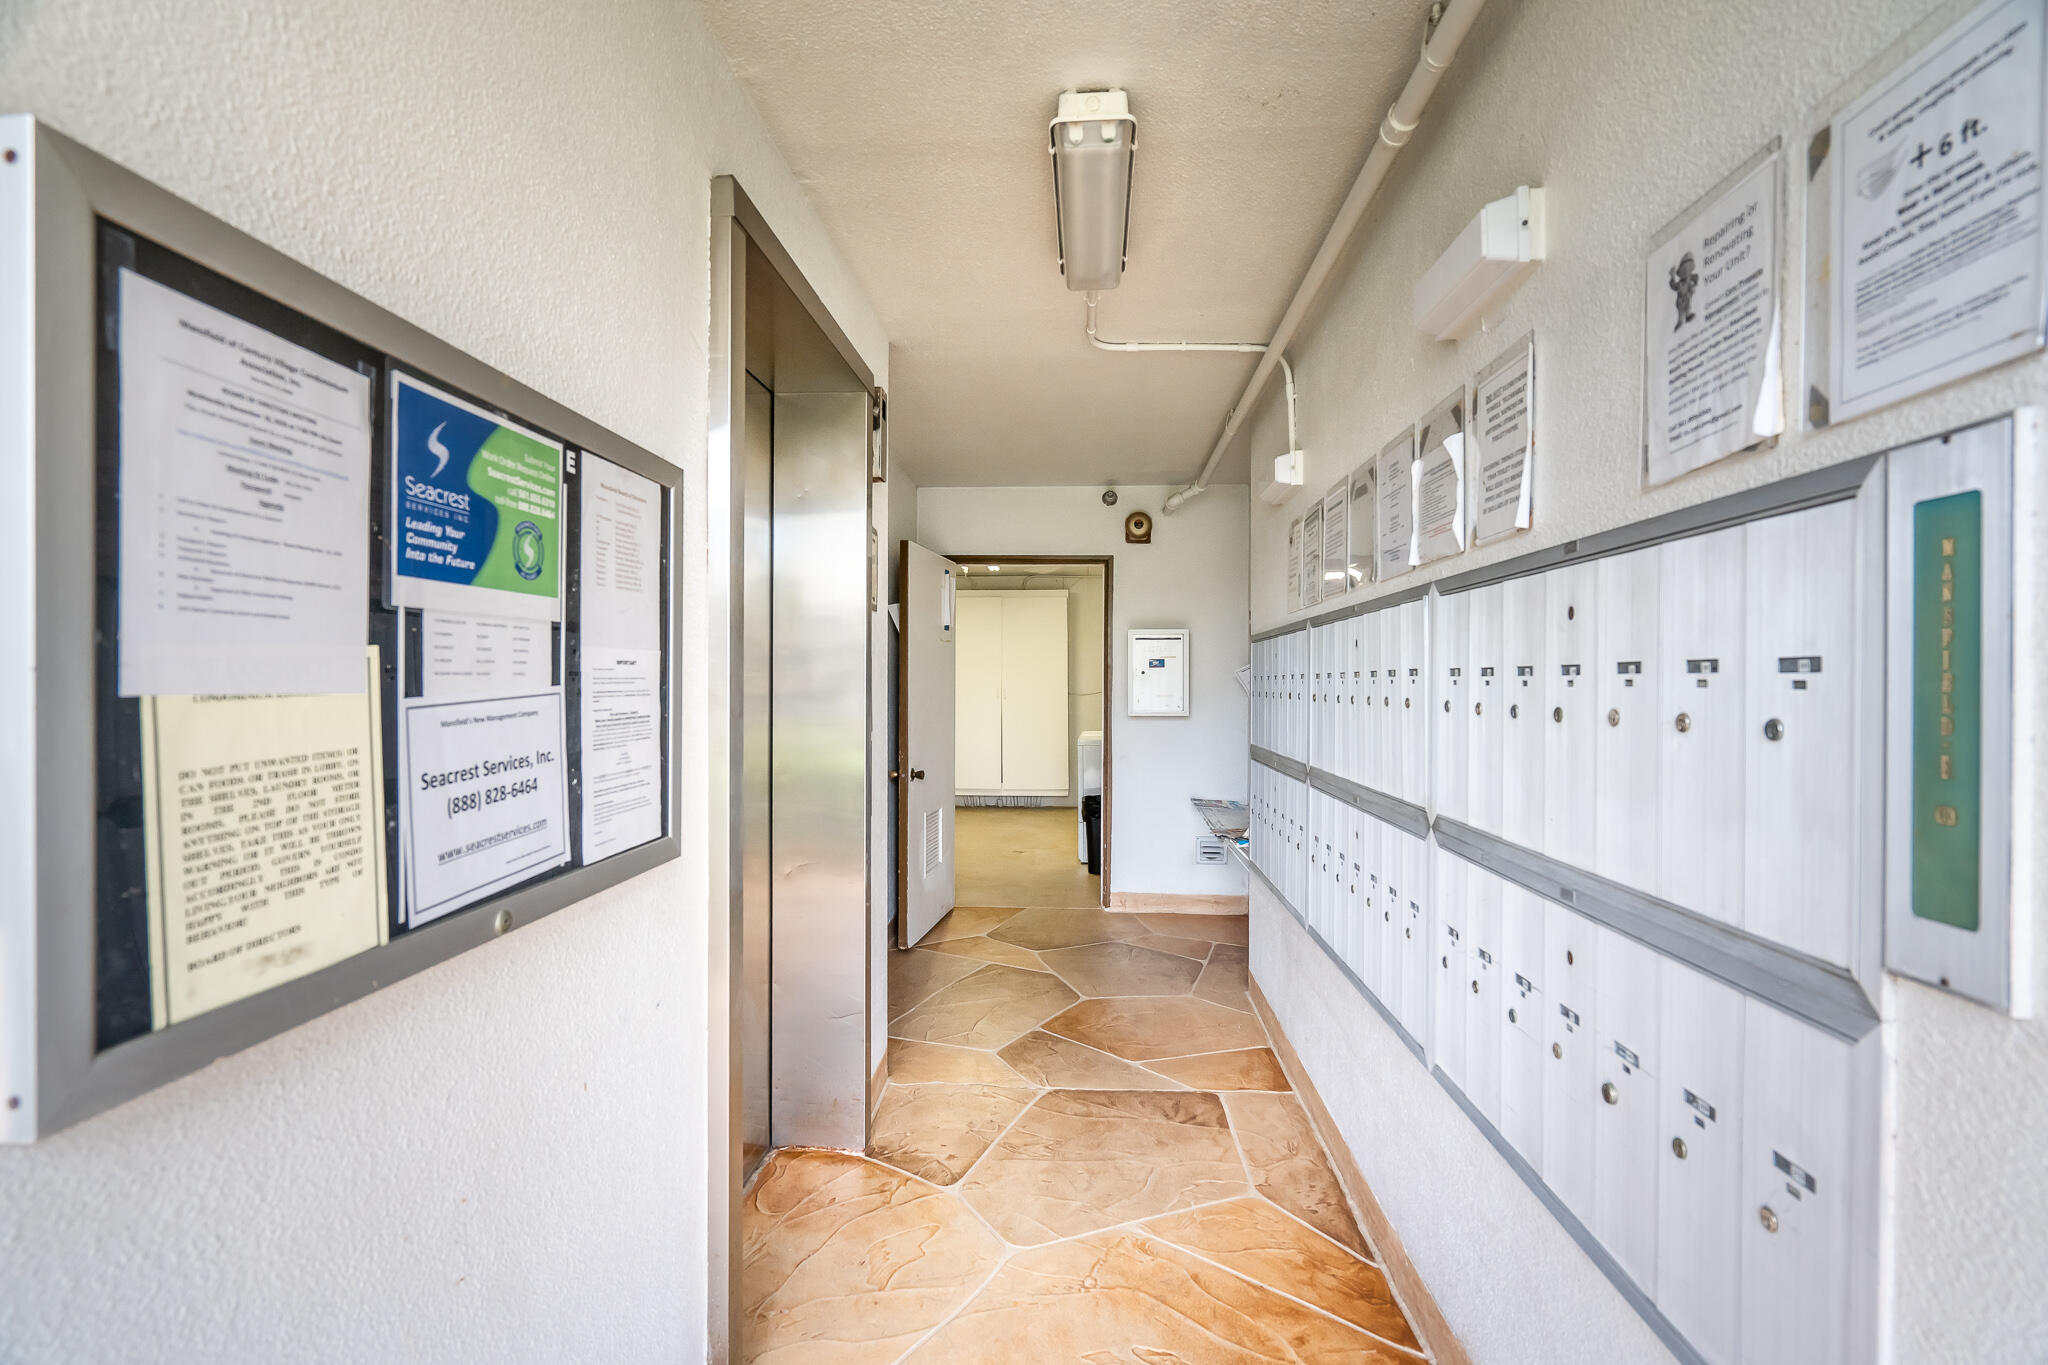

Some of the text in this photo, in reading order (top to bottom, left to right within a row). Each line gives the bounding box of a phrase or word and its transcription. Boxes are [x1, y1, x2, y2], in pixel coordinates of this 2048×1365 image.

[1938, 132, 1954, 156] 6
[1703, 210, 1746, 250] Repairing
[1703, 225, 1754, 268] Renovating
[1703, 266, 1724, 288] Your
[1725, 243, 1752, 272] Unit?
[404, 475, 470, 512] Seacrest
[404, 500, 450, 520] SERVICES
[404, 515, 467, 540] Leading Your
[404, 531, 459, 556] Community
[404, 546, 476, 571] Into the Future
[473, 714, 485, 724] New
[486, 711, 518, 723] Management
[518, 709, 539, 719] Company
[202, 765, 224, 776] NOT
[229, 762, 250, 772] PUT
[254, 754, 309, 770] UNWANTED
[420, 749, 555, 791] Seacrest Services, Inc.
[446, 777, 538, 820] (888) 828-6464
[238, 807, 276, 823] PLEASE
[437, 817, 548, 864] www.seacrestservices.com
